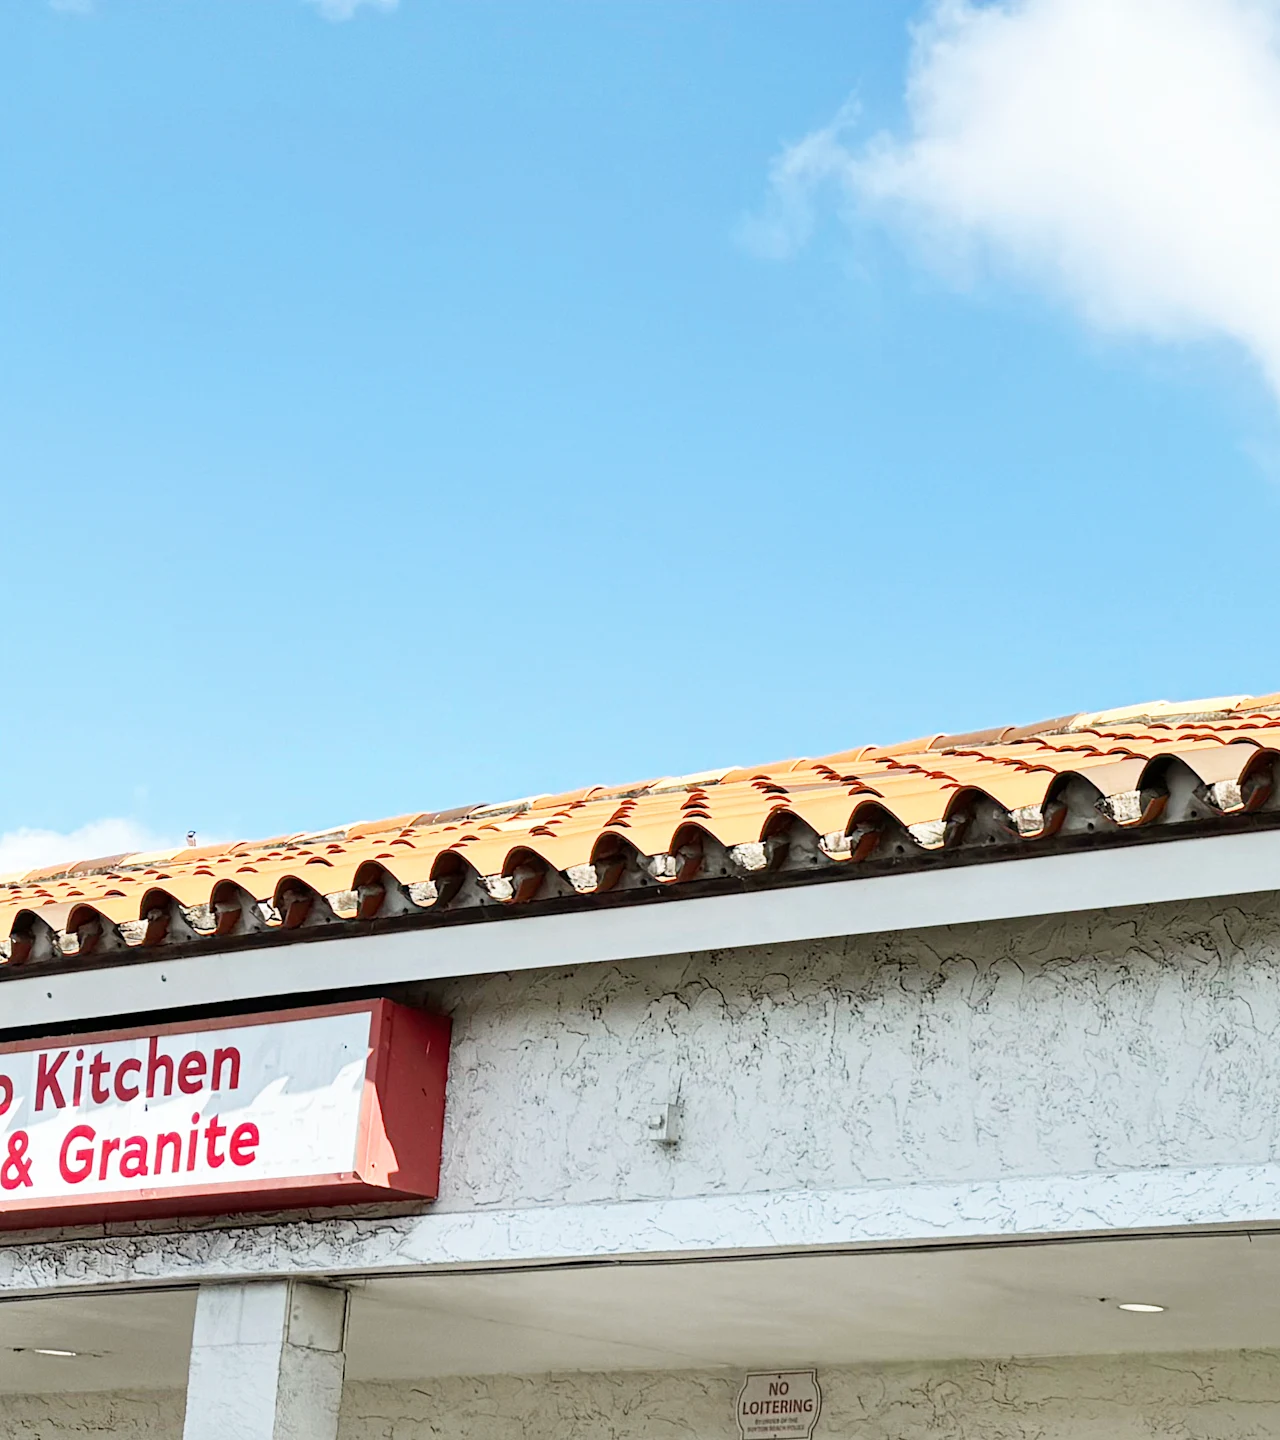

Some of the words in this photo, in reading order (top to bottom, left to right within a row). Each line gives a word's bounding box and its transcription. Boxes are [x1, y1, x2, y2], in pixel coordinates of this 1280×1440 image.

[35, 1036, 241, 1112] Kitchen
[0, 1130, 33, 1190] &
[59, 1112, 260, 1184] Granite
[742, 1399, 813, 1415] LOITERING
[769, 1381, 789, 1396] NO
